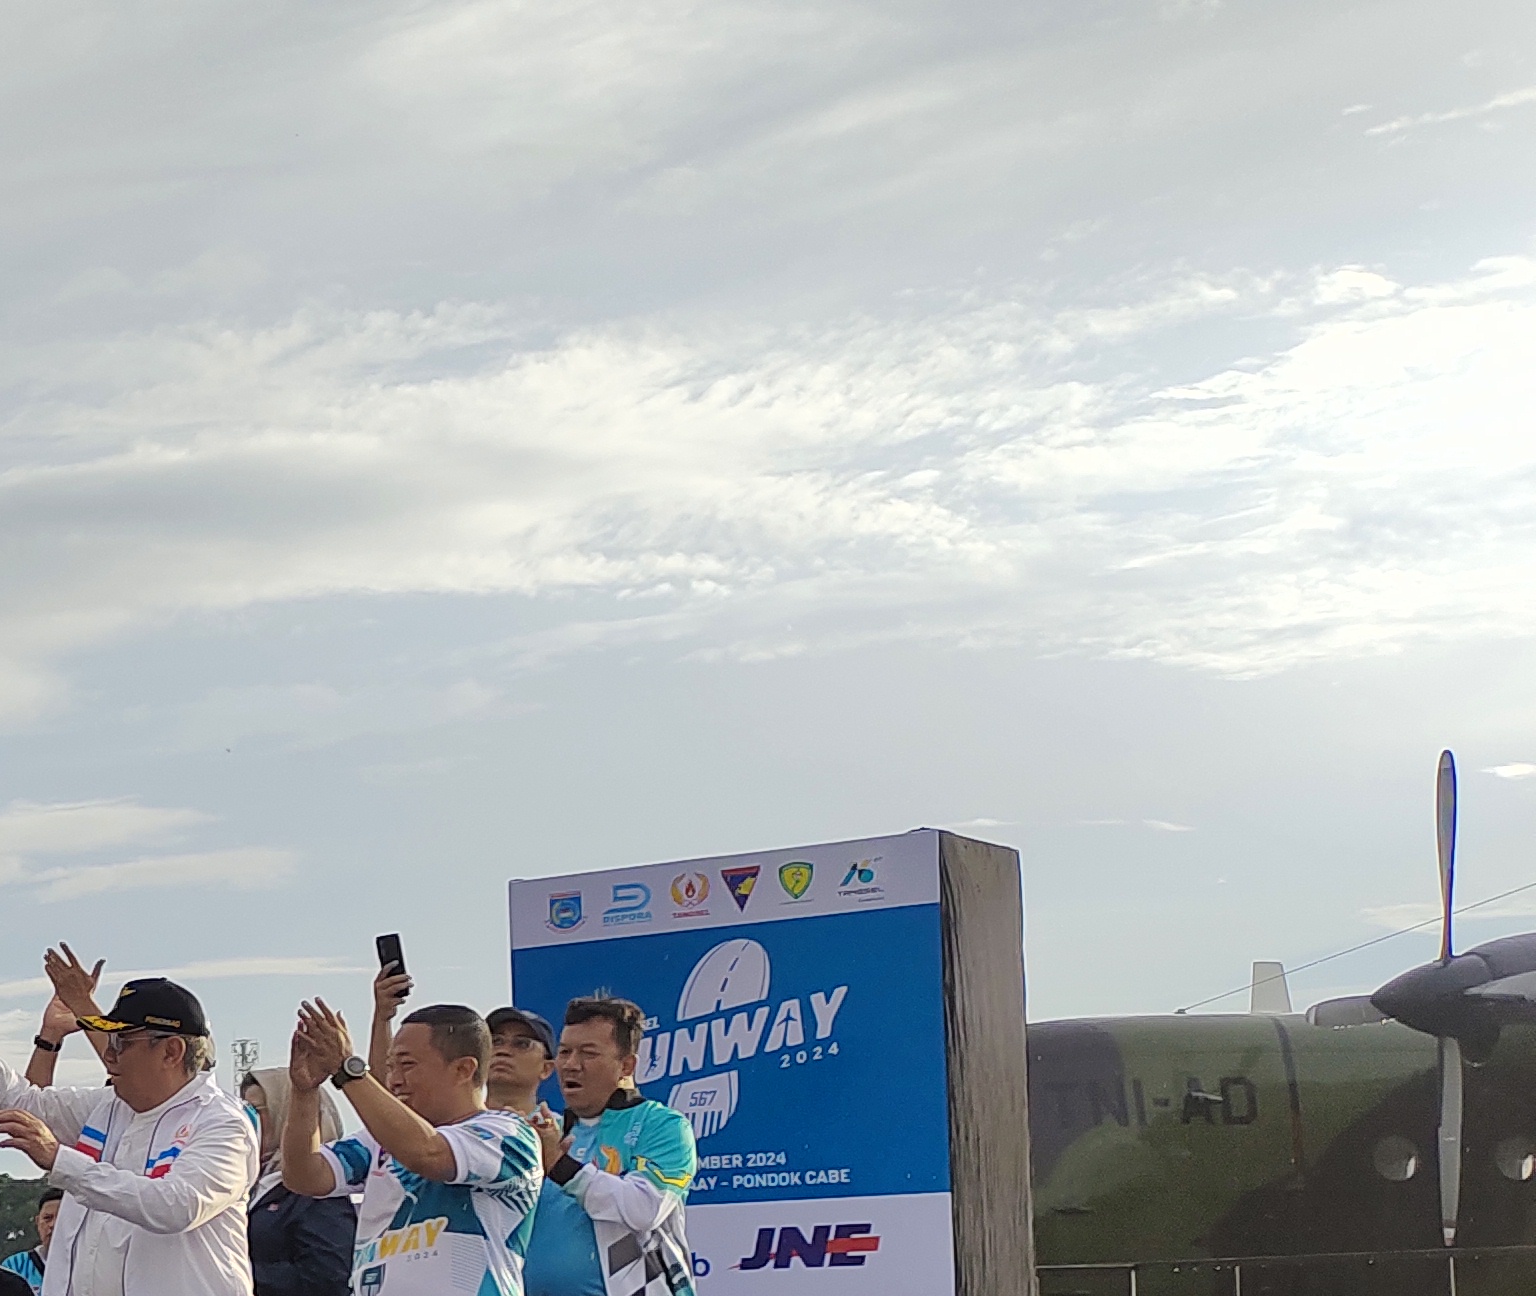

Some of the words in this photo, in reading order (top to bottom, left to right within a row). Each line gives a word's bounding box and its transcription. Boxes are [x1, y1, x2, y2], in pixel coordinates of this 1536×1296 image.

[634, 986, 848, 1085] UNWAY
[779, 1042, 840, 1069] 2024
[689, 1090, 718, 1107] 567
[697, 1153, 743, 1171] MBER
[746, 1151, 786, 1168] 2024
[731, 1172, 801, 1189] PONDOK
[805, 1169, 851, 1185] CABE
[740, 1223, 881, 1271] JNE
